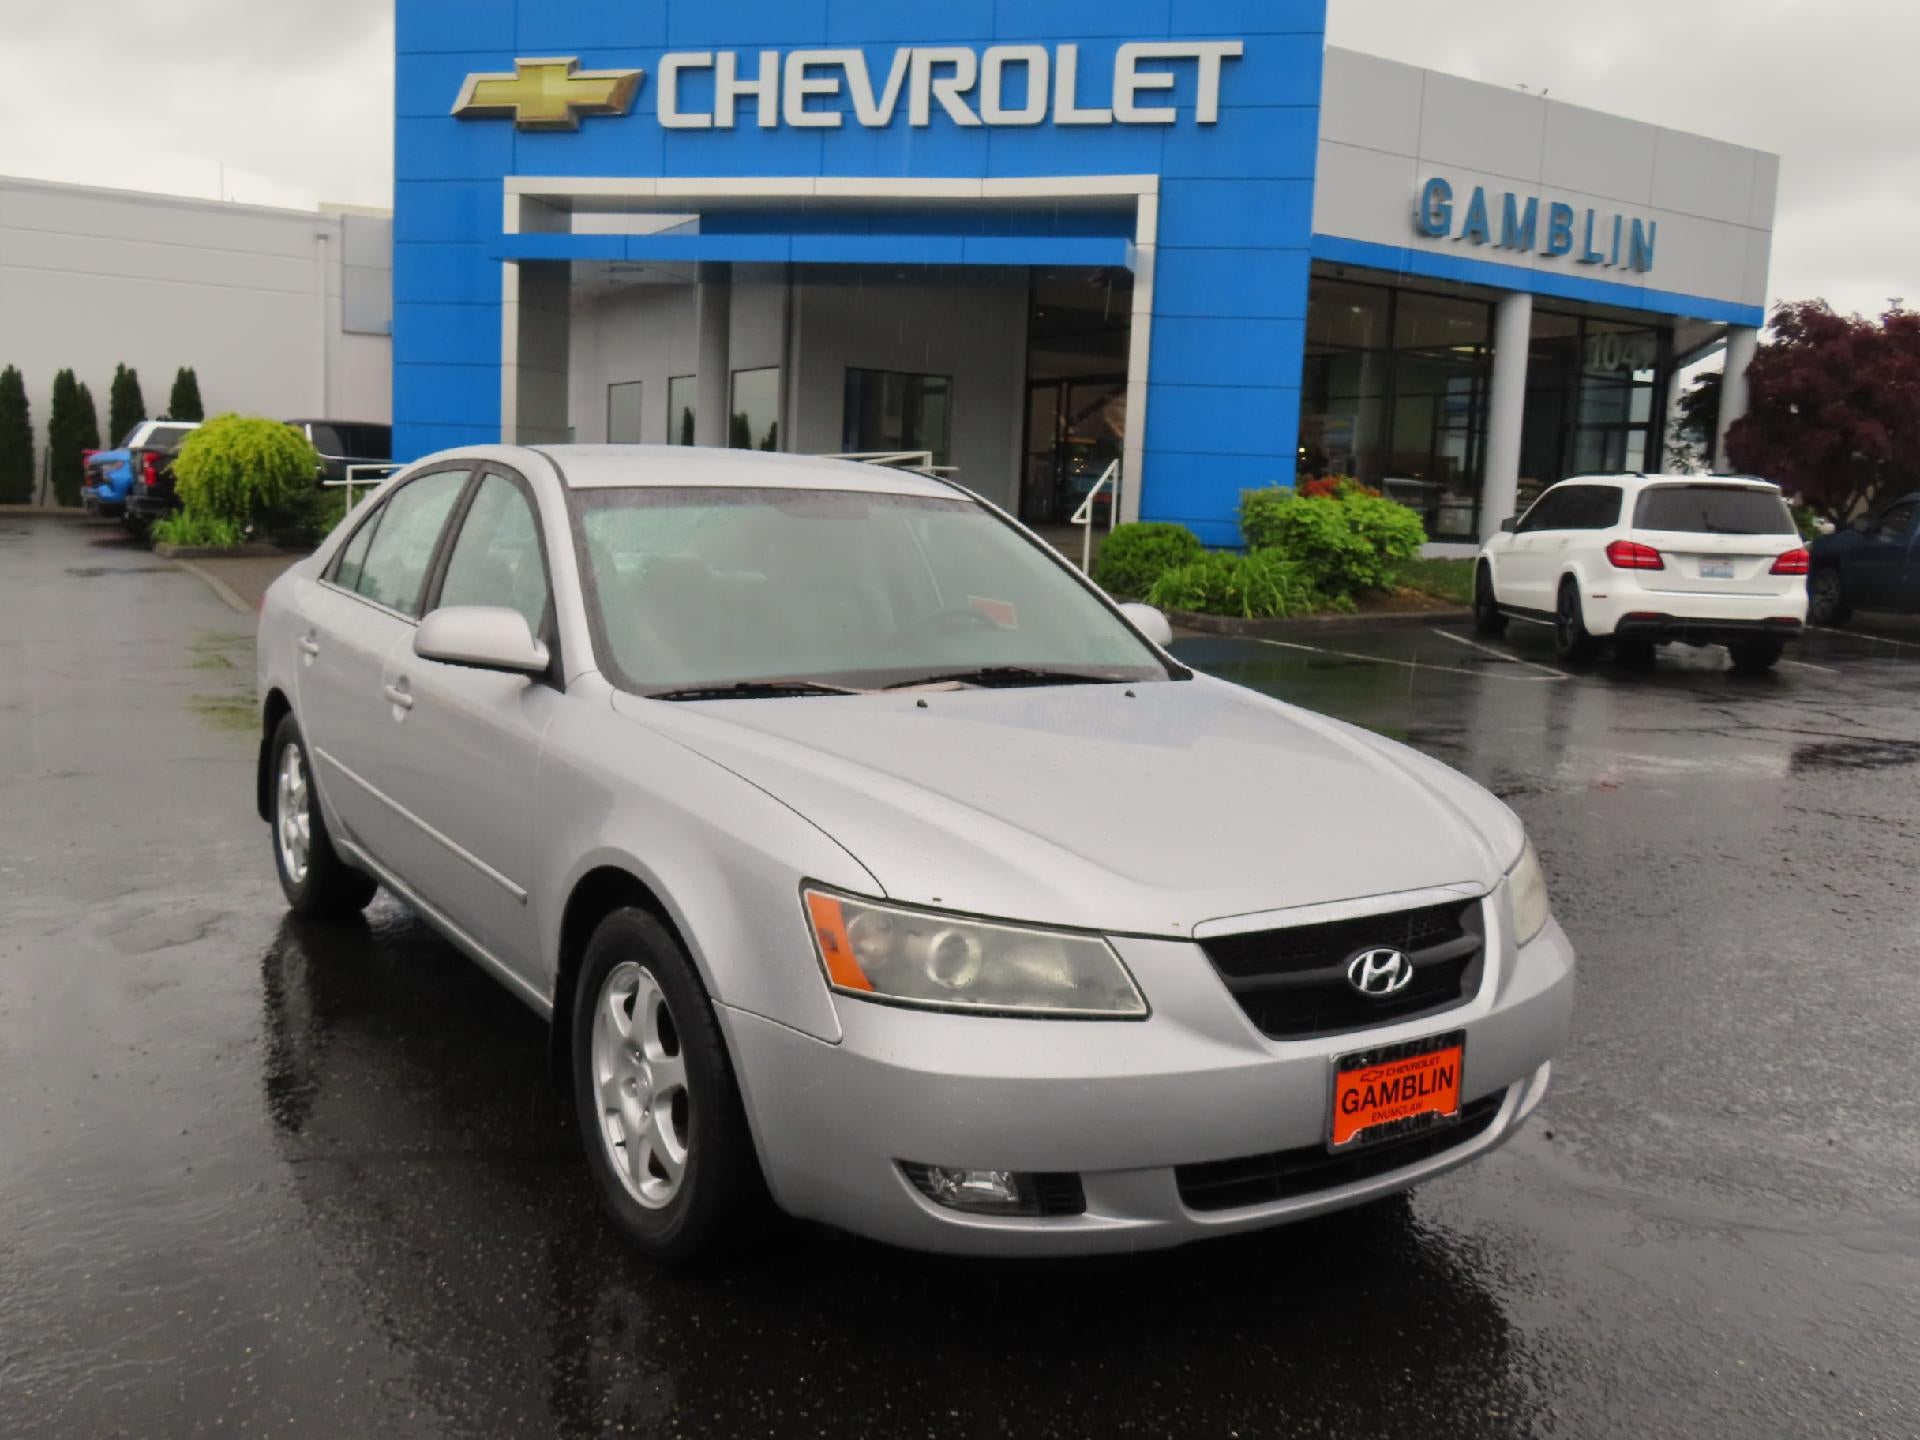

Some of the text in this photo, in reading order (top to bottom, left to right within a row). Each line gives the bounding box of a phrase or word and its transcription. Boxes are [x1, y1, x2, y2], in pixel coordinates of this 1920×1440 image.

[657, 41, 1244, 129] CHEVROLET
[1420, 177, 1657, 272] GAMBLIN
[1341, 1064, 1454, 1115] GAMBLIN
[1386, 1056, 1440, 1077] CHEVROLET
[1371, 1102, 1422, 1122] ENUMCLAW
